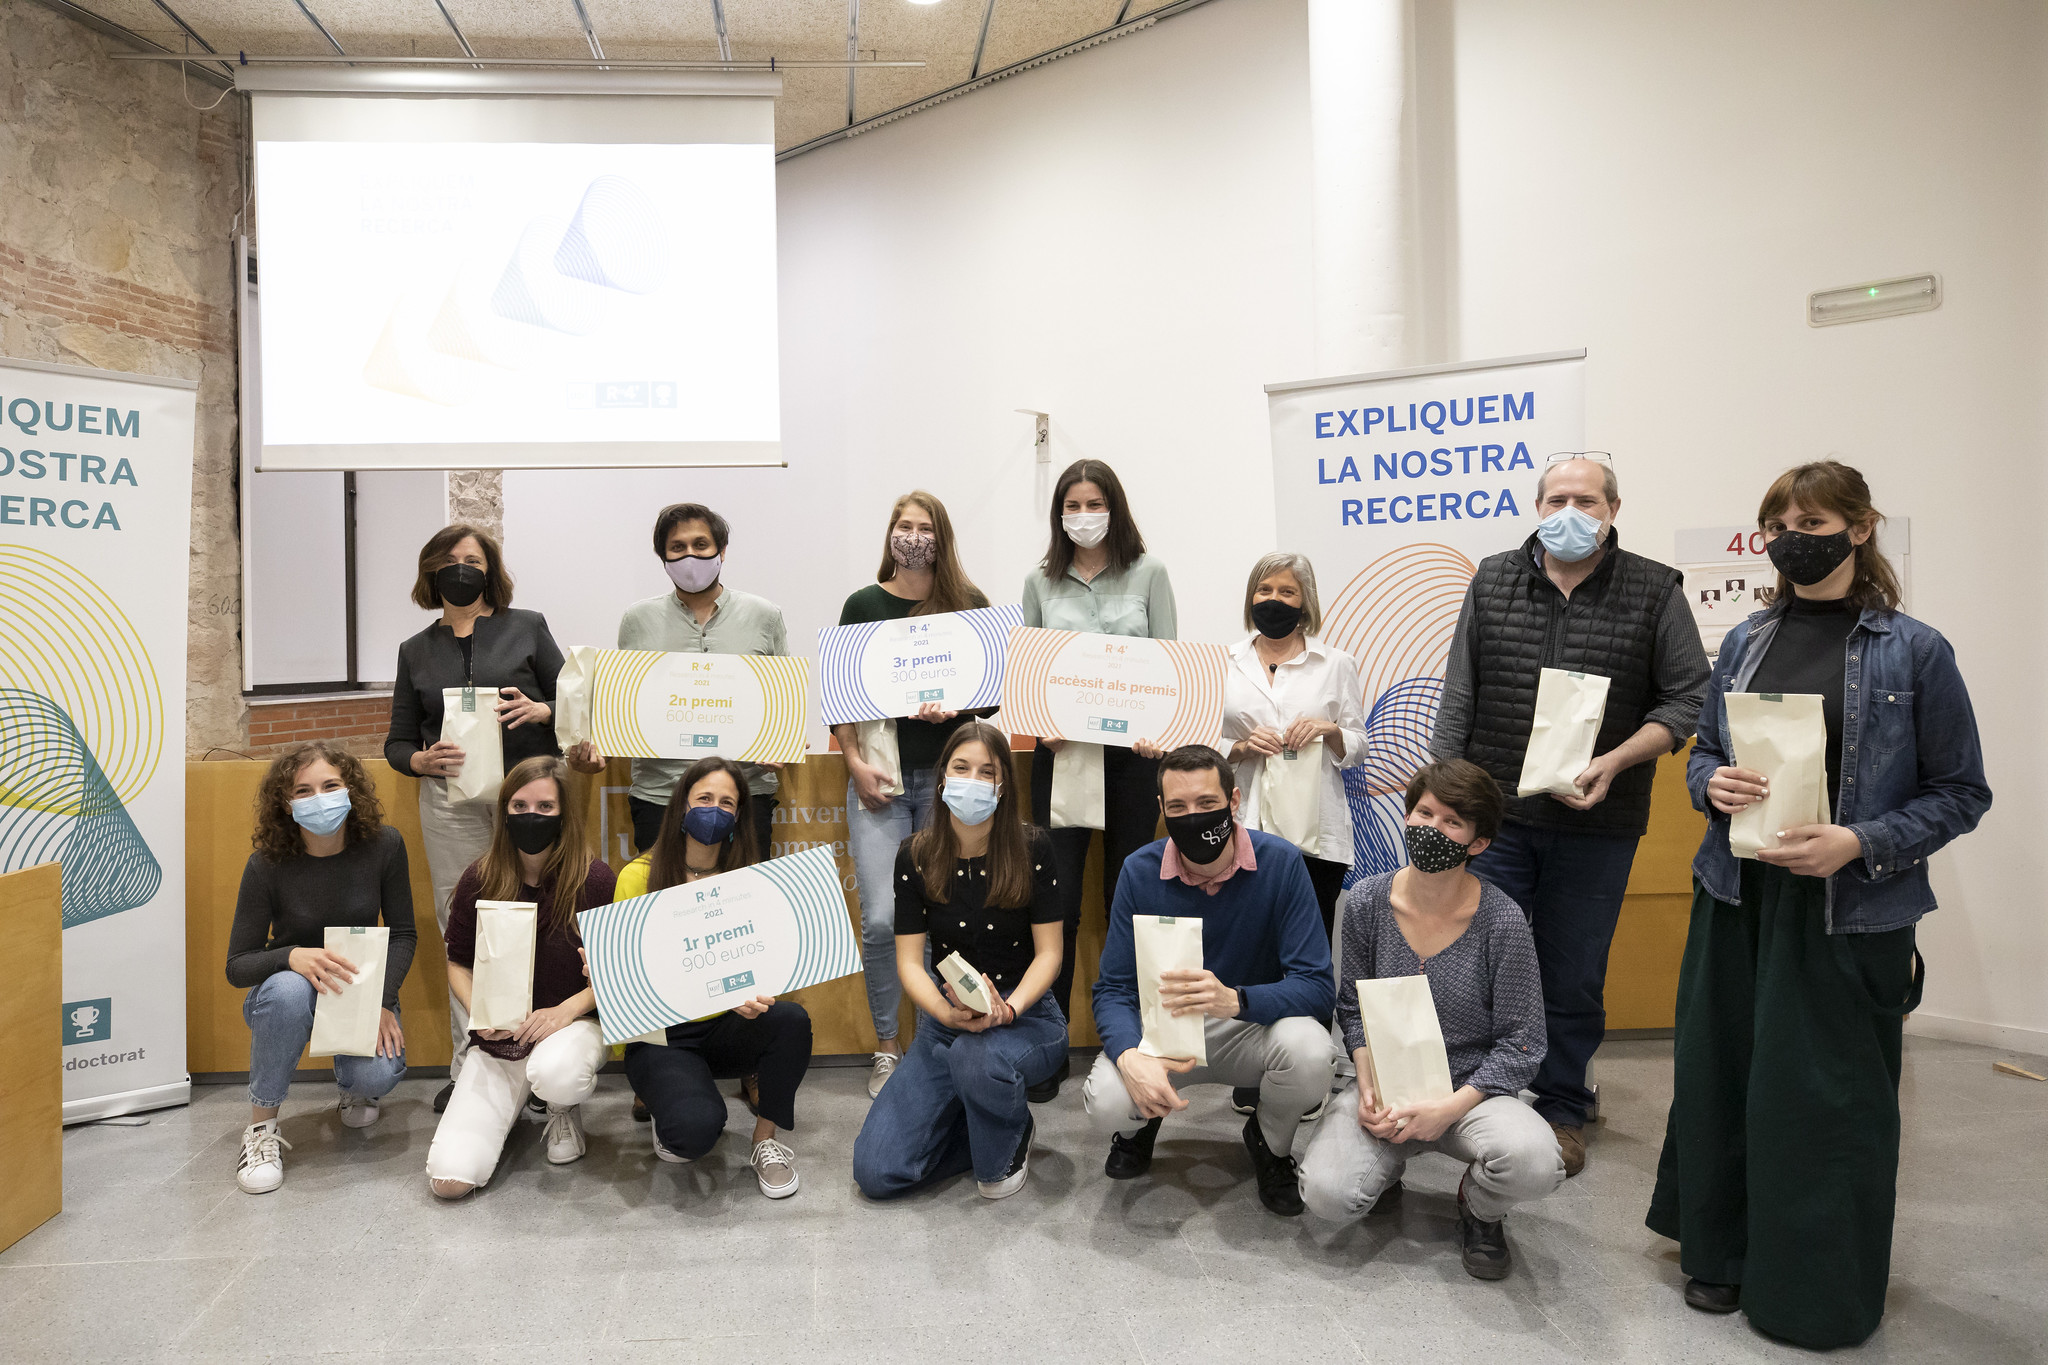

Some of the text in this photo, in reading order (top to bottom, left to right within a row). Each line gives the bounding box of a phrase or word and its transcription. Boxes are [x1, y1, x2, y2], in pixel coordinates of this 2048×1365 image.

[0, 396, 140, 438] QUEM
[1314, 391, 1536, 439] EXPLIQUEM
[1317, 441, 1535, 485] LA NOSTRA
[1341, 488, 1520, 526] RECERCA
[913, 639, 929, 647] 2021
[893, 650, 952, 669] 3r premi
[890, 667, 957, 683] 300 euros
[1049, 674, 1177, 697] accèssit als premis
[668, 694, 733, 710] 2n premi
[1075, 690, 1146, 711] 200 euros
[666, 709, 734, 724] 600 euros
[703, 908, 724, 919] 2021
[682, 919, 755, 952] 1r premi
[682, 940, 766, 973] 900 euros
